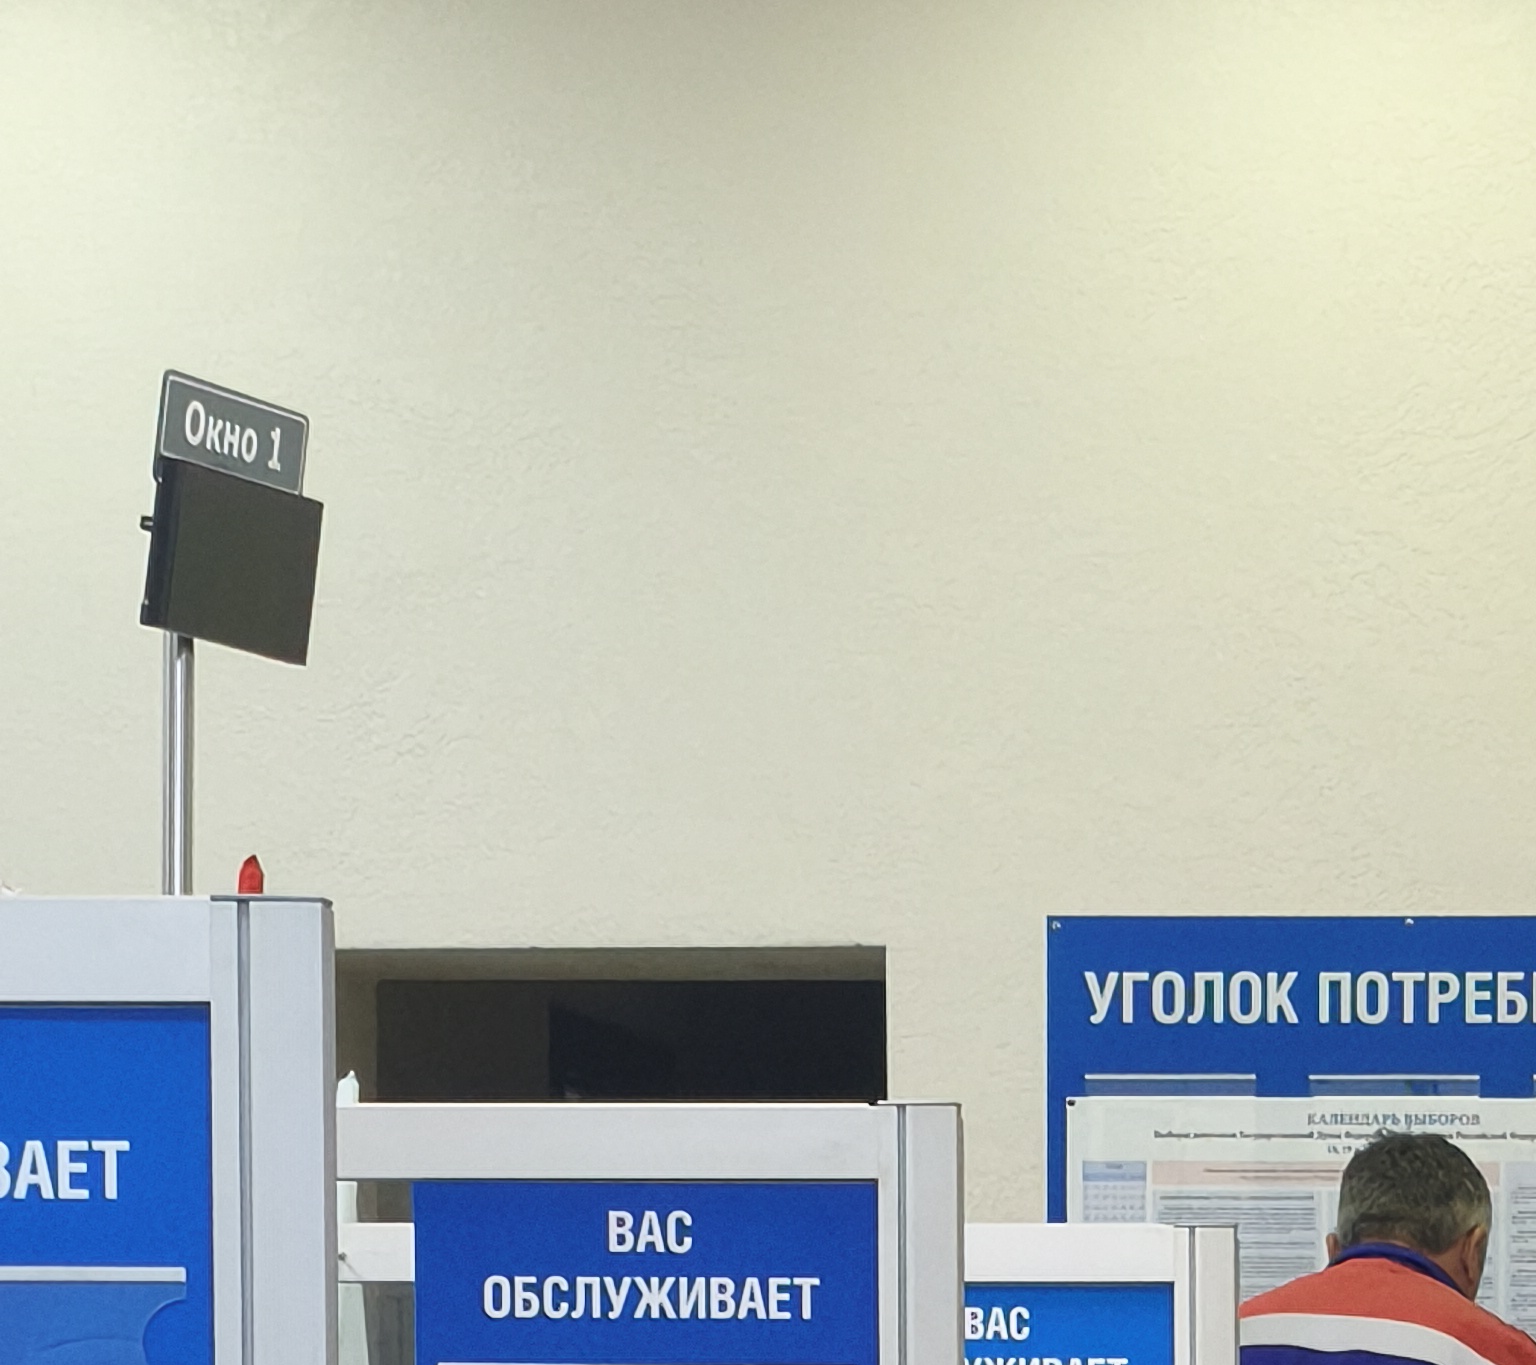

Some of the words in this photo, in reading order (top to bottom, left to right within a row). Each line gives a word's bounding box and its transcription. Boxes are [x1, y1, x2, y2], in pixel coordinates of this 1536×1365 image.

[185, 400, 258, 463] Окно
[267, 426, 281, 472] 1
[1084, 970, 1299, 1025] УГОЛОК
[1306, 1112, 1402, 1127] КАЛЕНДАРЬ
[607, 1210, 693, 1254] ВАС
[482, 1275, 821, 1320] ОБСЛУЖИВАЕТ
[964, 1306, 1031, 1341] ВАС
